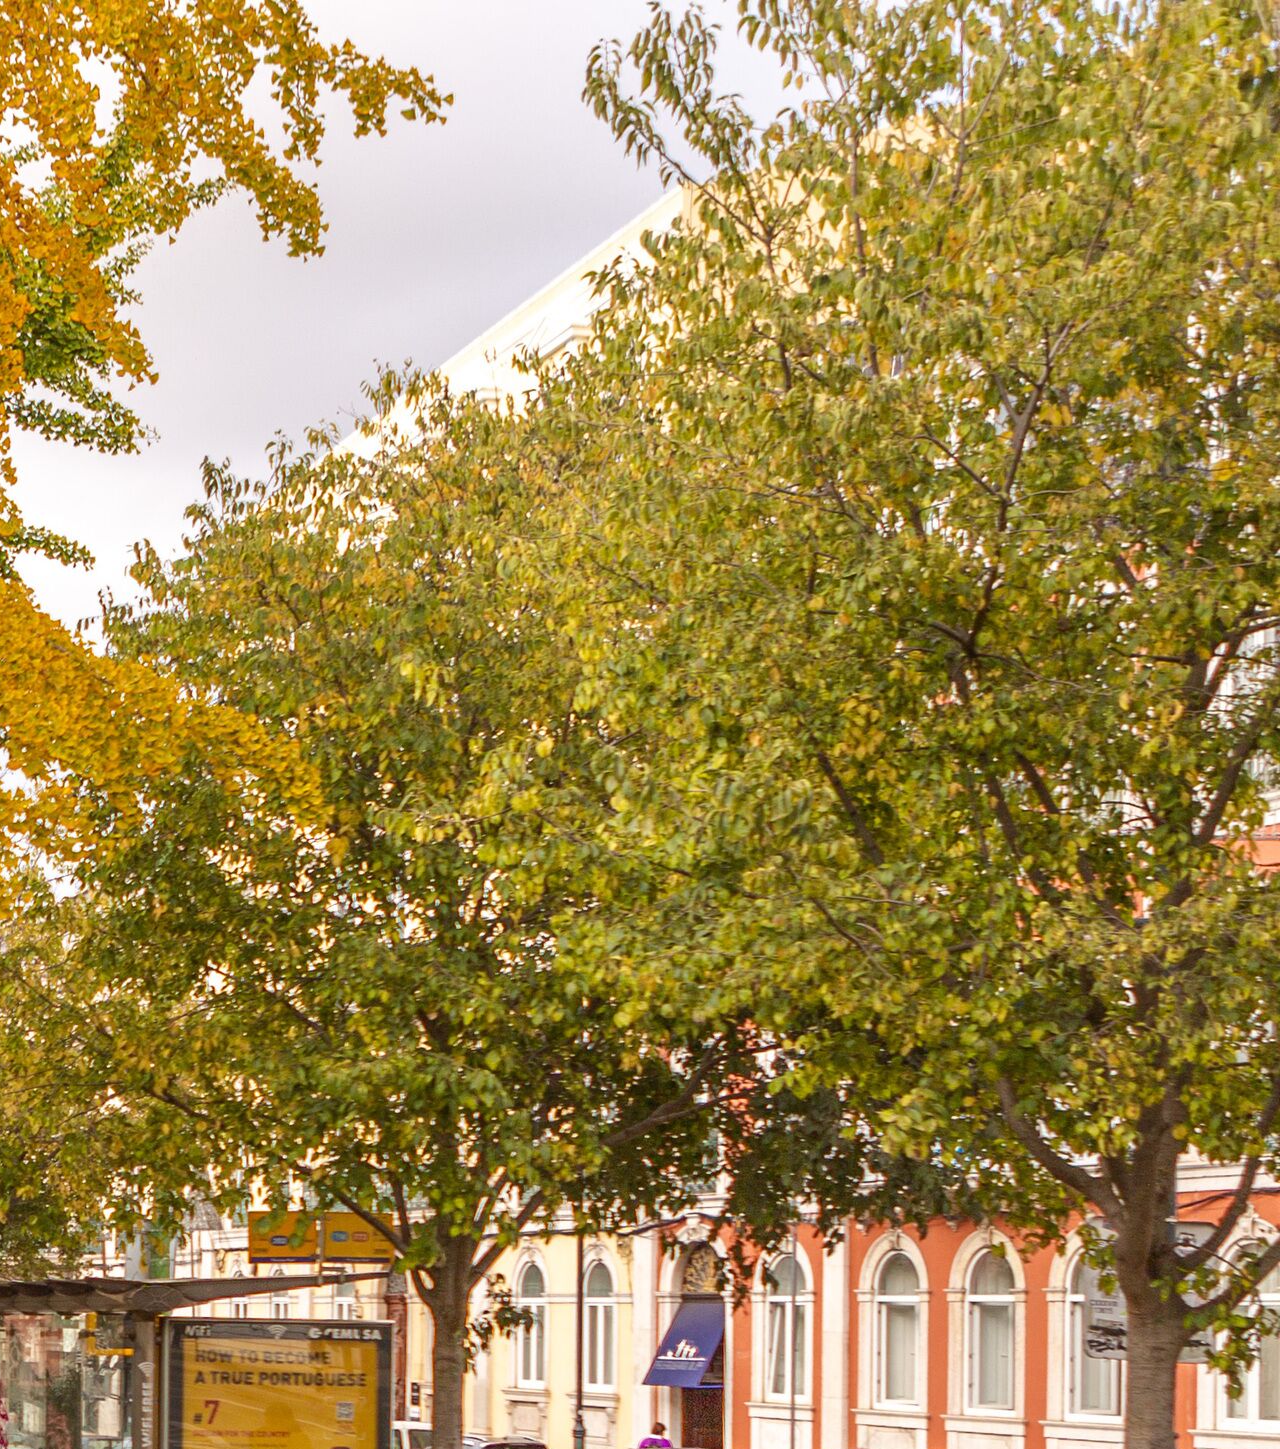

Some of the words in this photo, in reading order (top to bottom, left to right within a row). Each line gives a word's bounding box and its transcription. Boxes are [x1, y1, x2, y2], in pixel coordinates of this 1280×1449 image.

[196, 1350, 232, 1364] HOW
[238, 1351, 258, 1364] TO
[264, 1352, 331, 1365] BECOME
[194, 1371, 205, 1385] A
[211, 1371, 253, 1385] TRUE
[258, 1372, 367, 1387] PORTUGUESE
[141, 1382, 153, 1412] FREE
